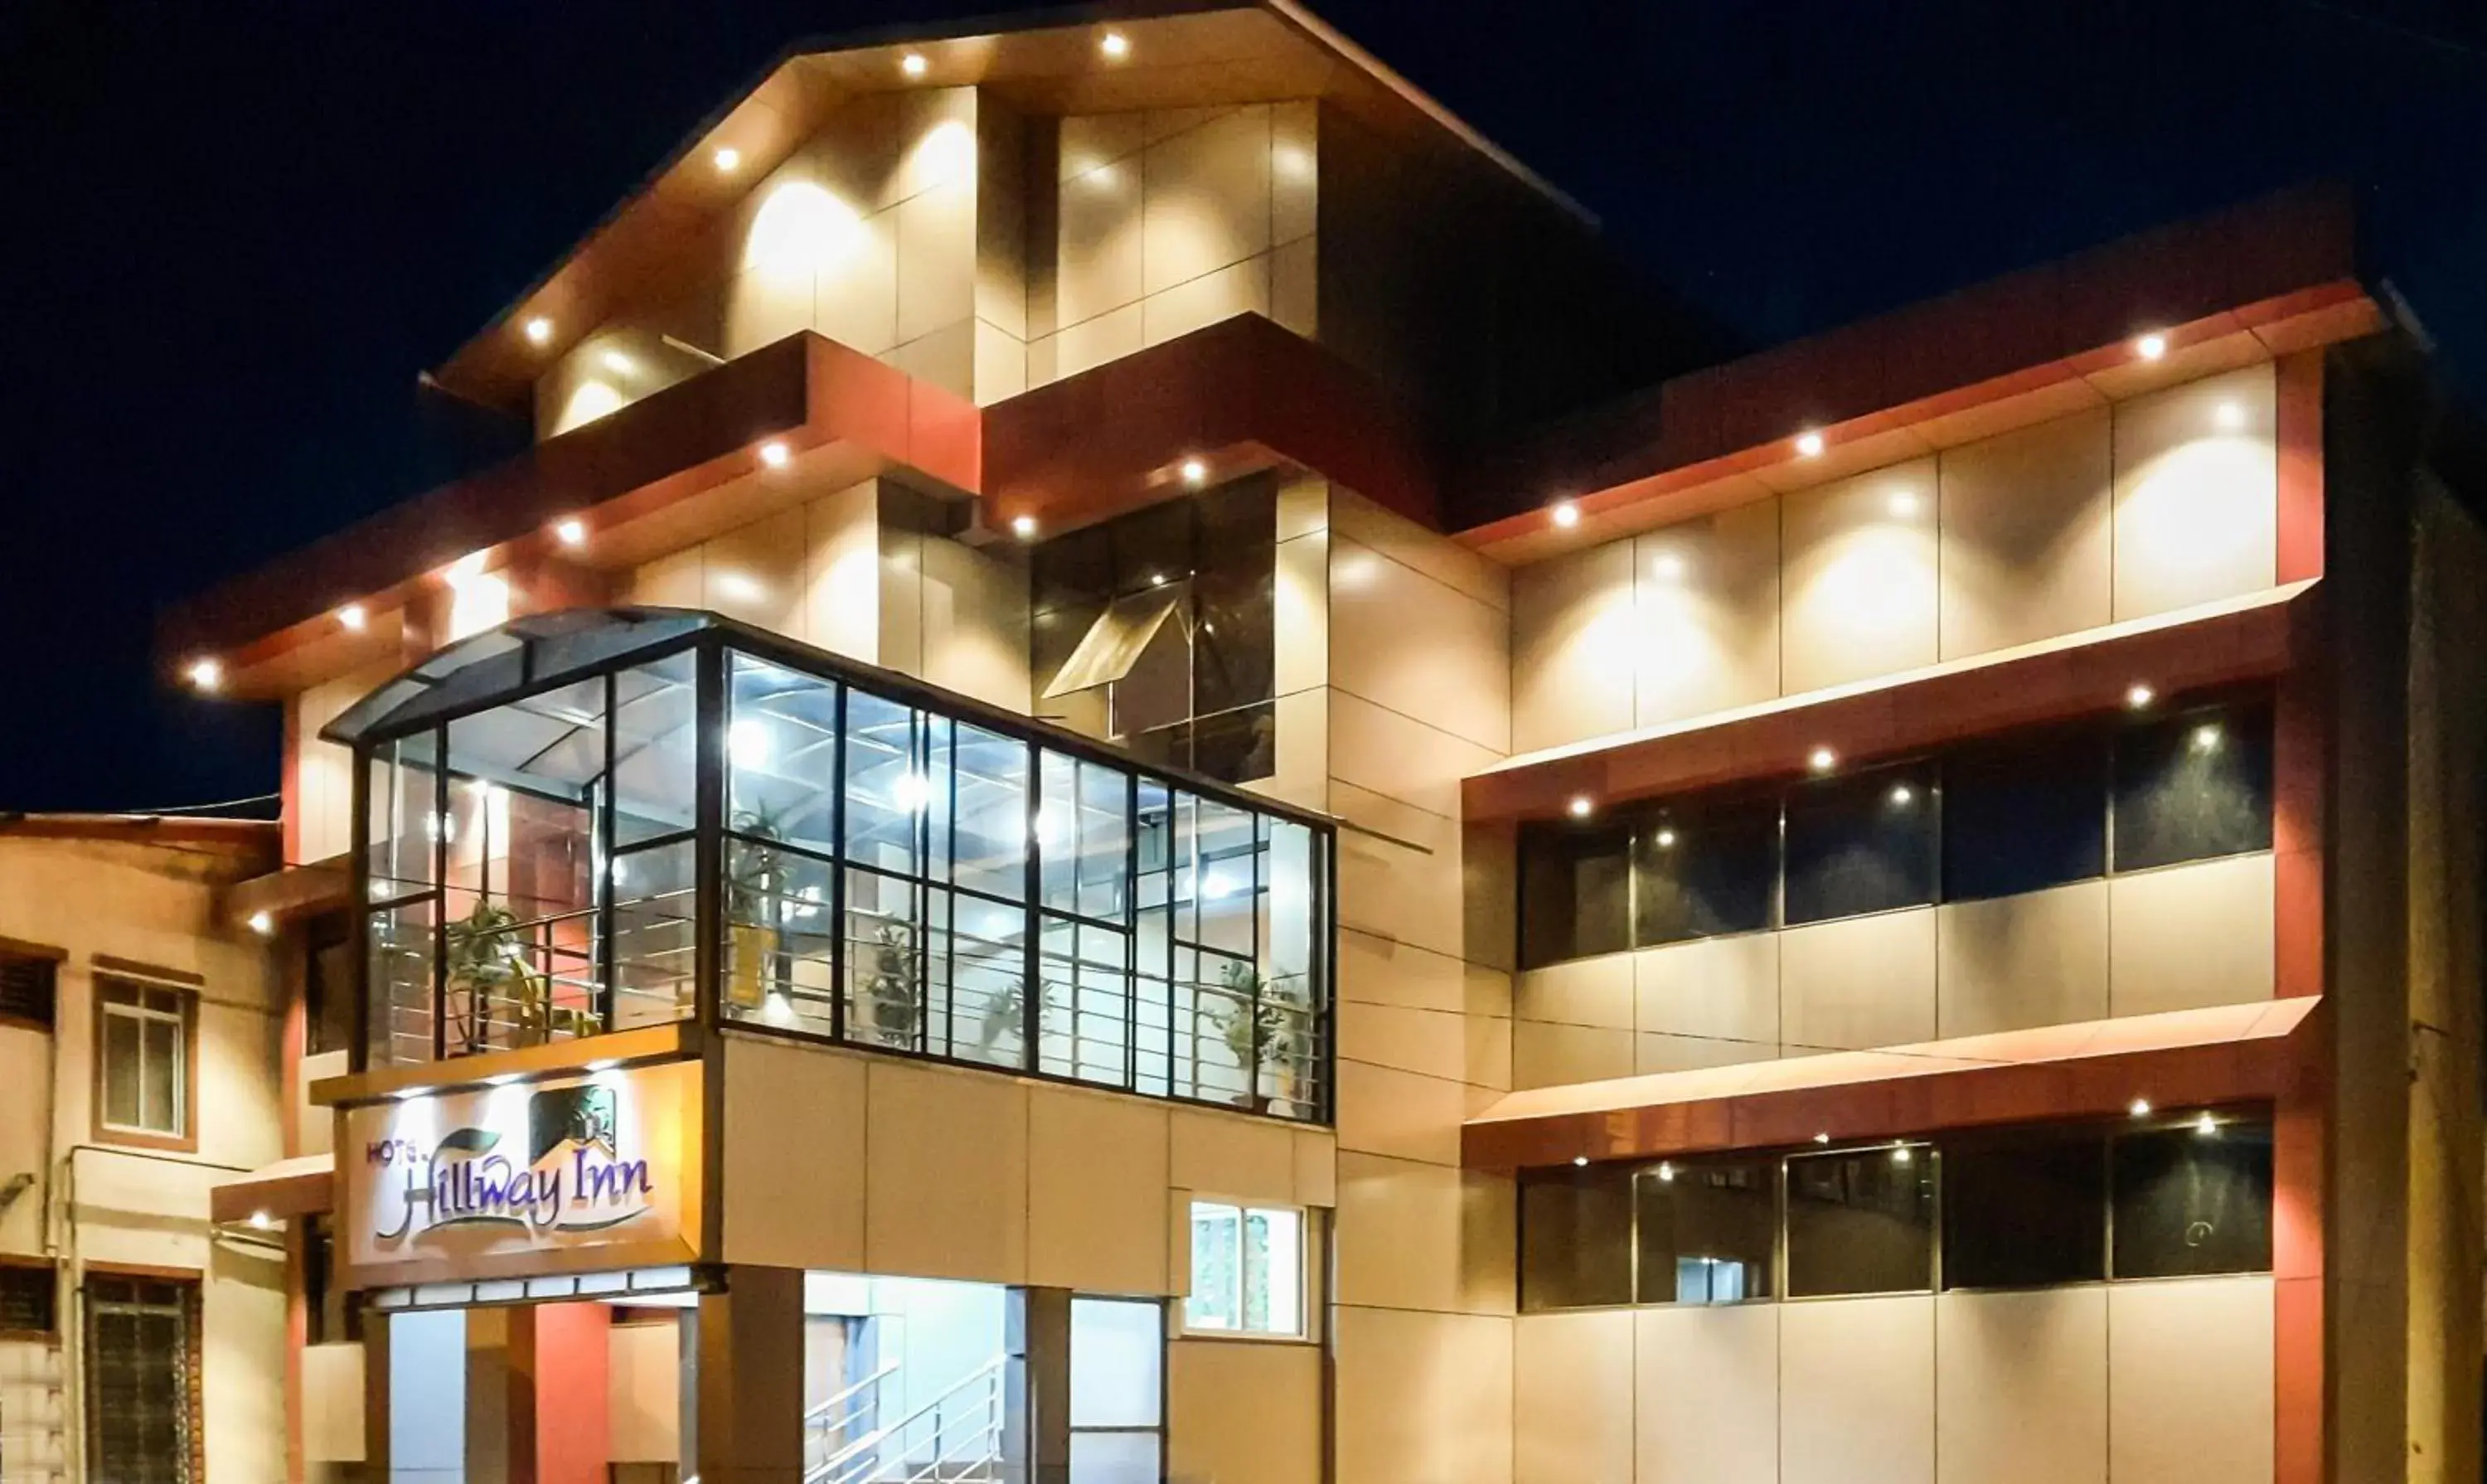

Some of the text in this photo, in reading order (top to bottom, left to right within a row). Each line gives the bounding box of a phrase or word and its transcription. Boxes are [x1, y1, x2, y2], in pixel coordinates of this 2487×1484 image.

[366, 1139, 429, 1167] HOTE
[377, 1128, 654, 1239] Hillway Inn
